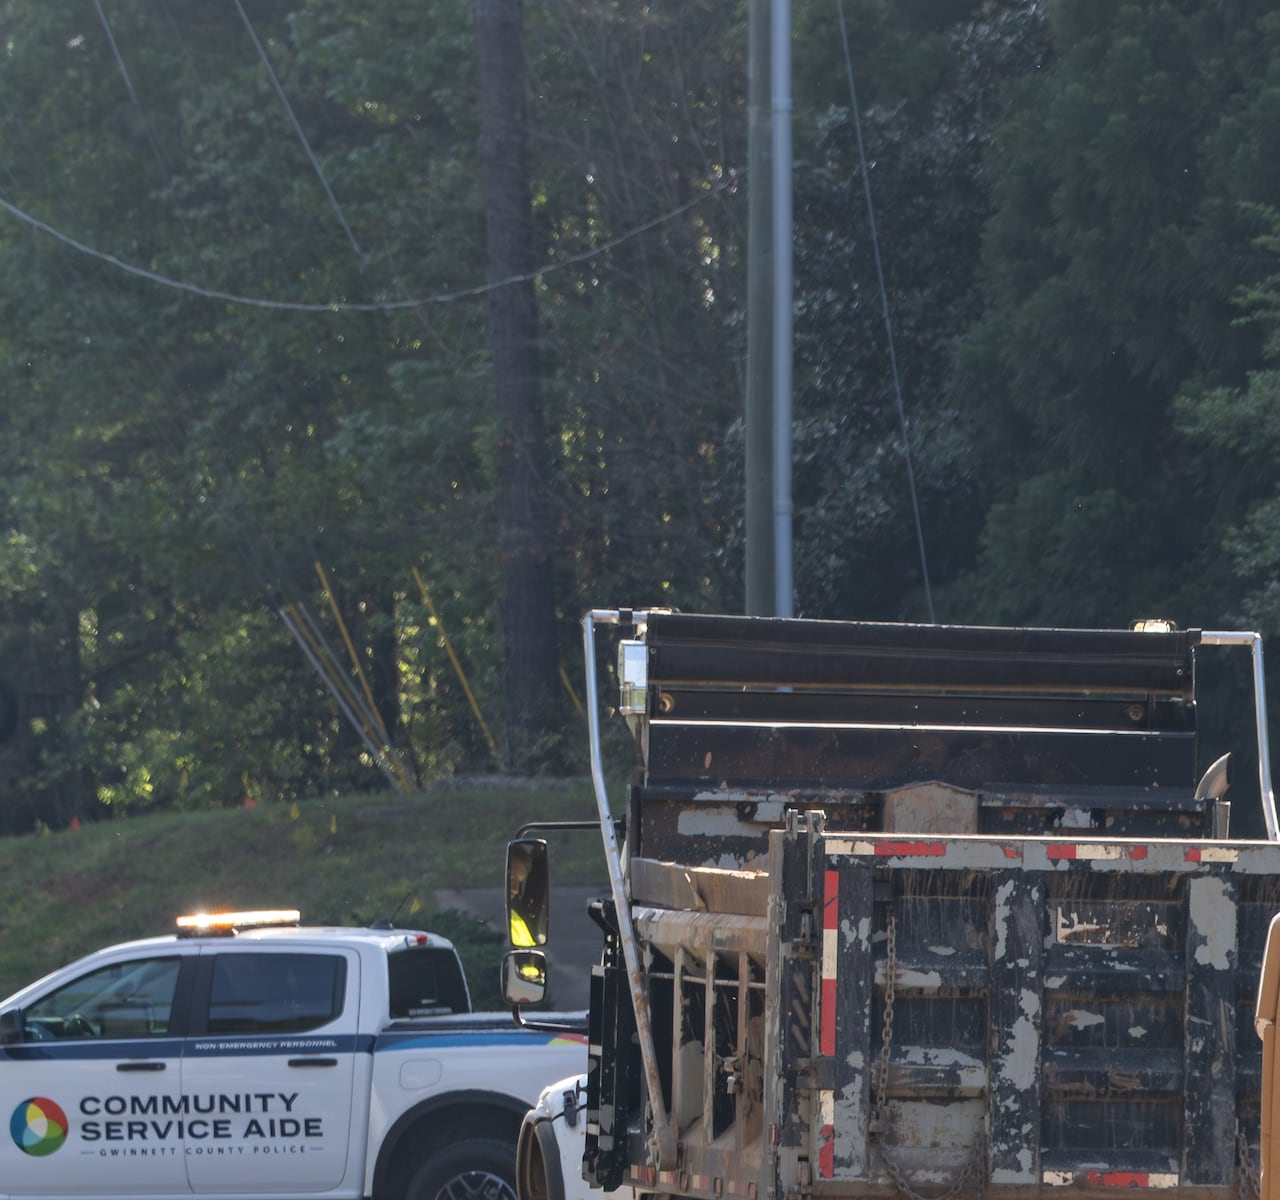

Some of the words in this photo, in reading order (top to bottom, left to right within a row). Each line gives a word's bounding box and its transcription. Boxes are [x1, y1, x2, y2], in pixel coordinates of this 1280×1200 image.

[280, 1039, 337, 1049] PERSONNEL
[79, 1092, 299, 1116] COMMUNITY
[80, 1119, 232, 1142] SERVICE
[242, 1117, 323, 1139] AIDE
[100, 1147, 176, 1157] GWINNETT
[185, 1146, 244, 1156] COUNTY
[253, 1145, 306, 1155] POLICE
